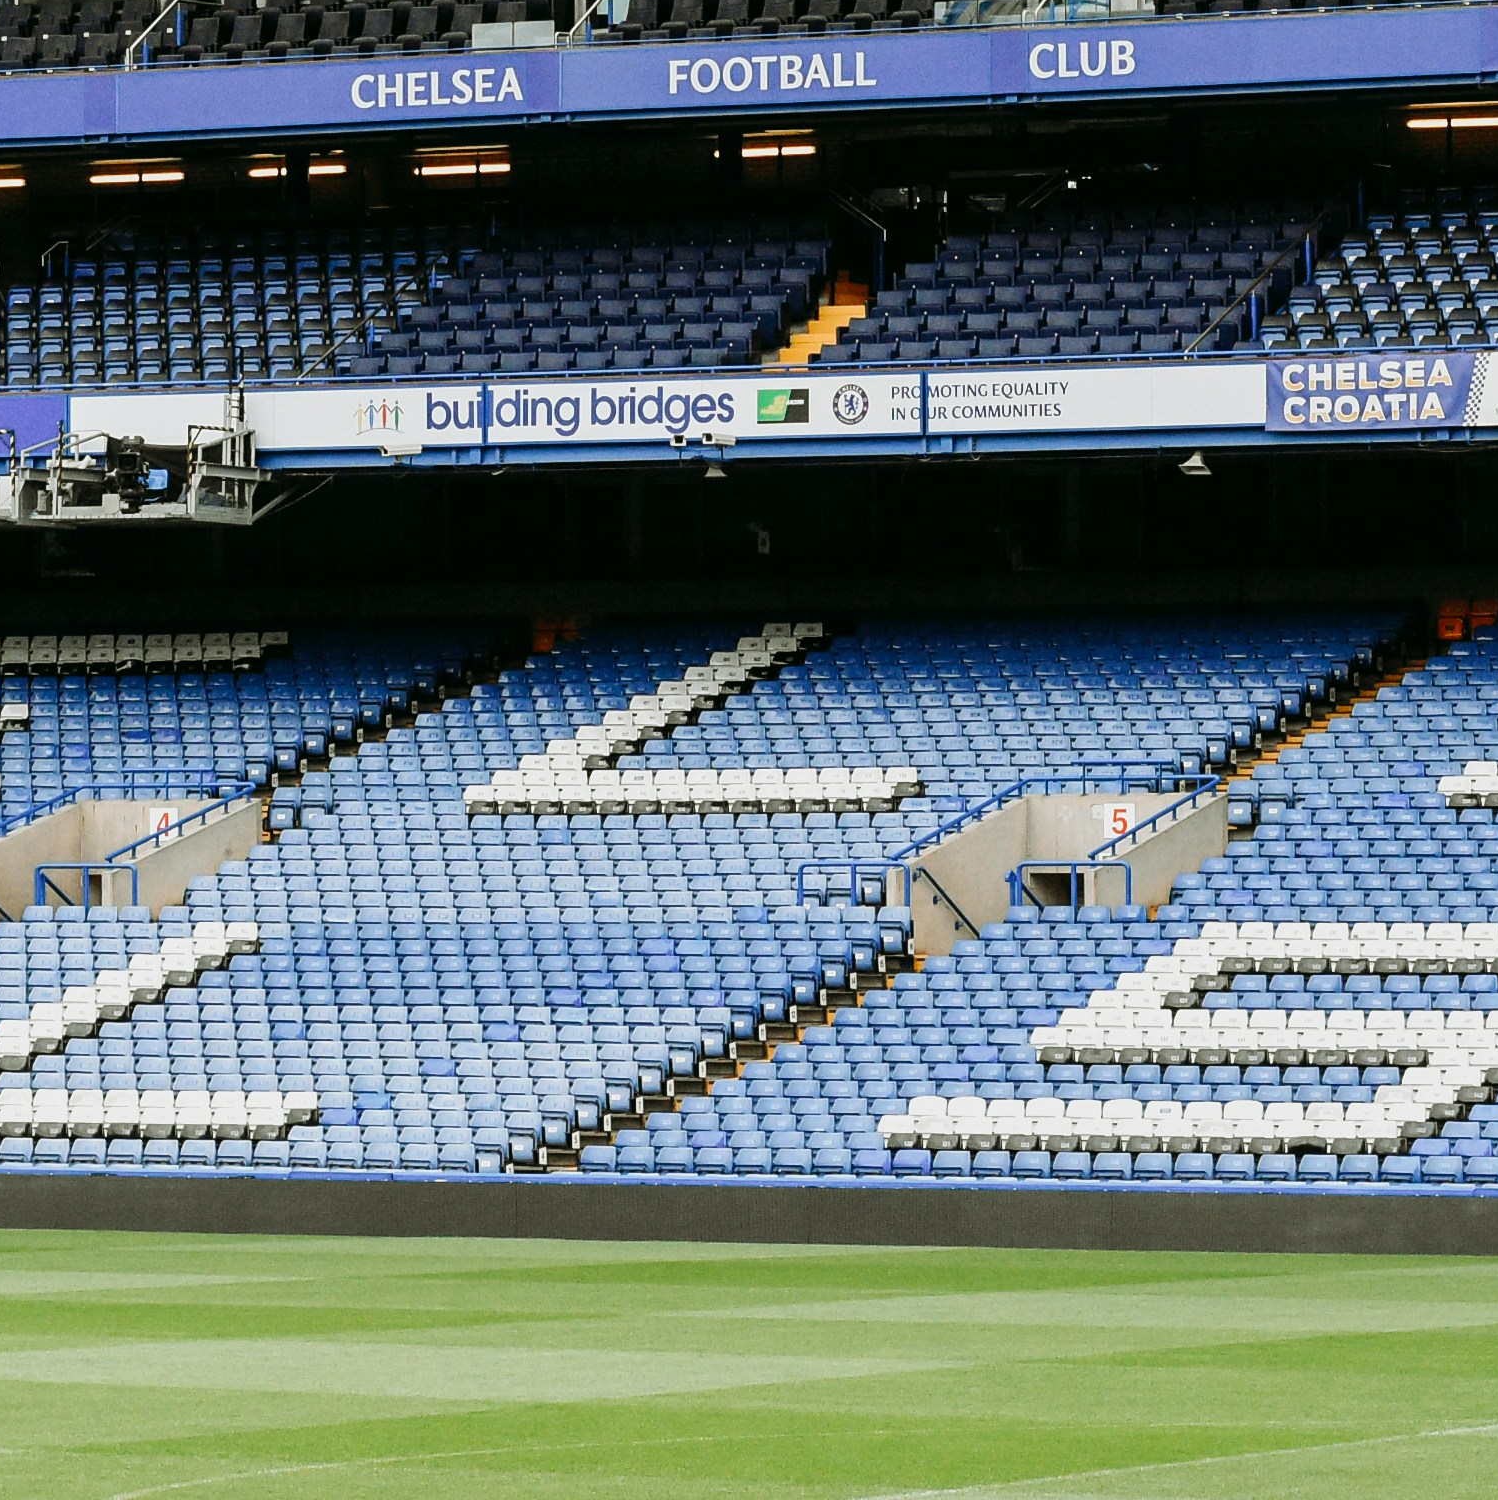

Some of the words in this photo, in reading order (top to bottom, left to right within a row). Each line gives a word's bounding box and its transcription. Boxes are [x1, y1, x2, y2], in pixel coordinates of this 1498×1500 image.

[350, 67, 524, 109] CHELSEA
[667, 51, 877, 94] FOOTBALL
[1029, 40, 1135, 79] CLUB
[1281, 359, 1453, 392] CHELSEA
[891, 383, 988, 400] PROMOTING
[992, 381, 1069, 399] EQUALITY
[426, 387, 580, 437] building
[590, 386, 735, 434] bridges
[891, 406, 906, 420] IN
[910, 405, 948, 420] OUR
[951, 403, 1062, 420] COMMUNITIES
[1283, 391, 1445, 424] CROATIA
[156, 812, 170, 837] 4
[1111, 809, 1128, 835] 5
